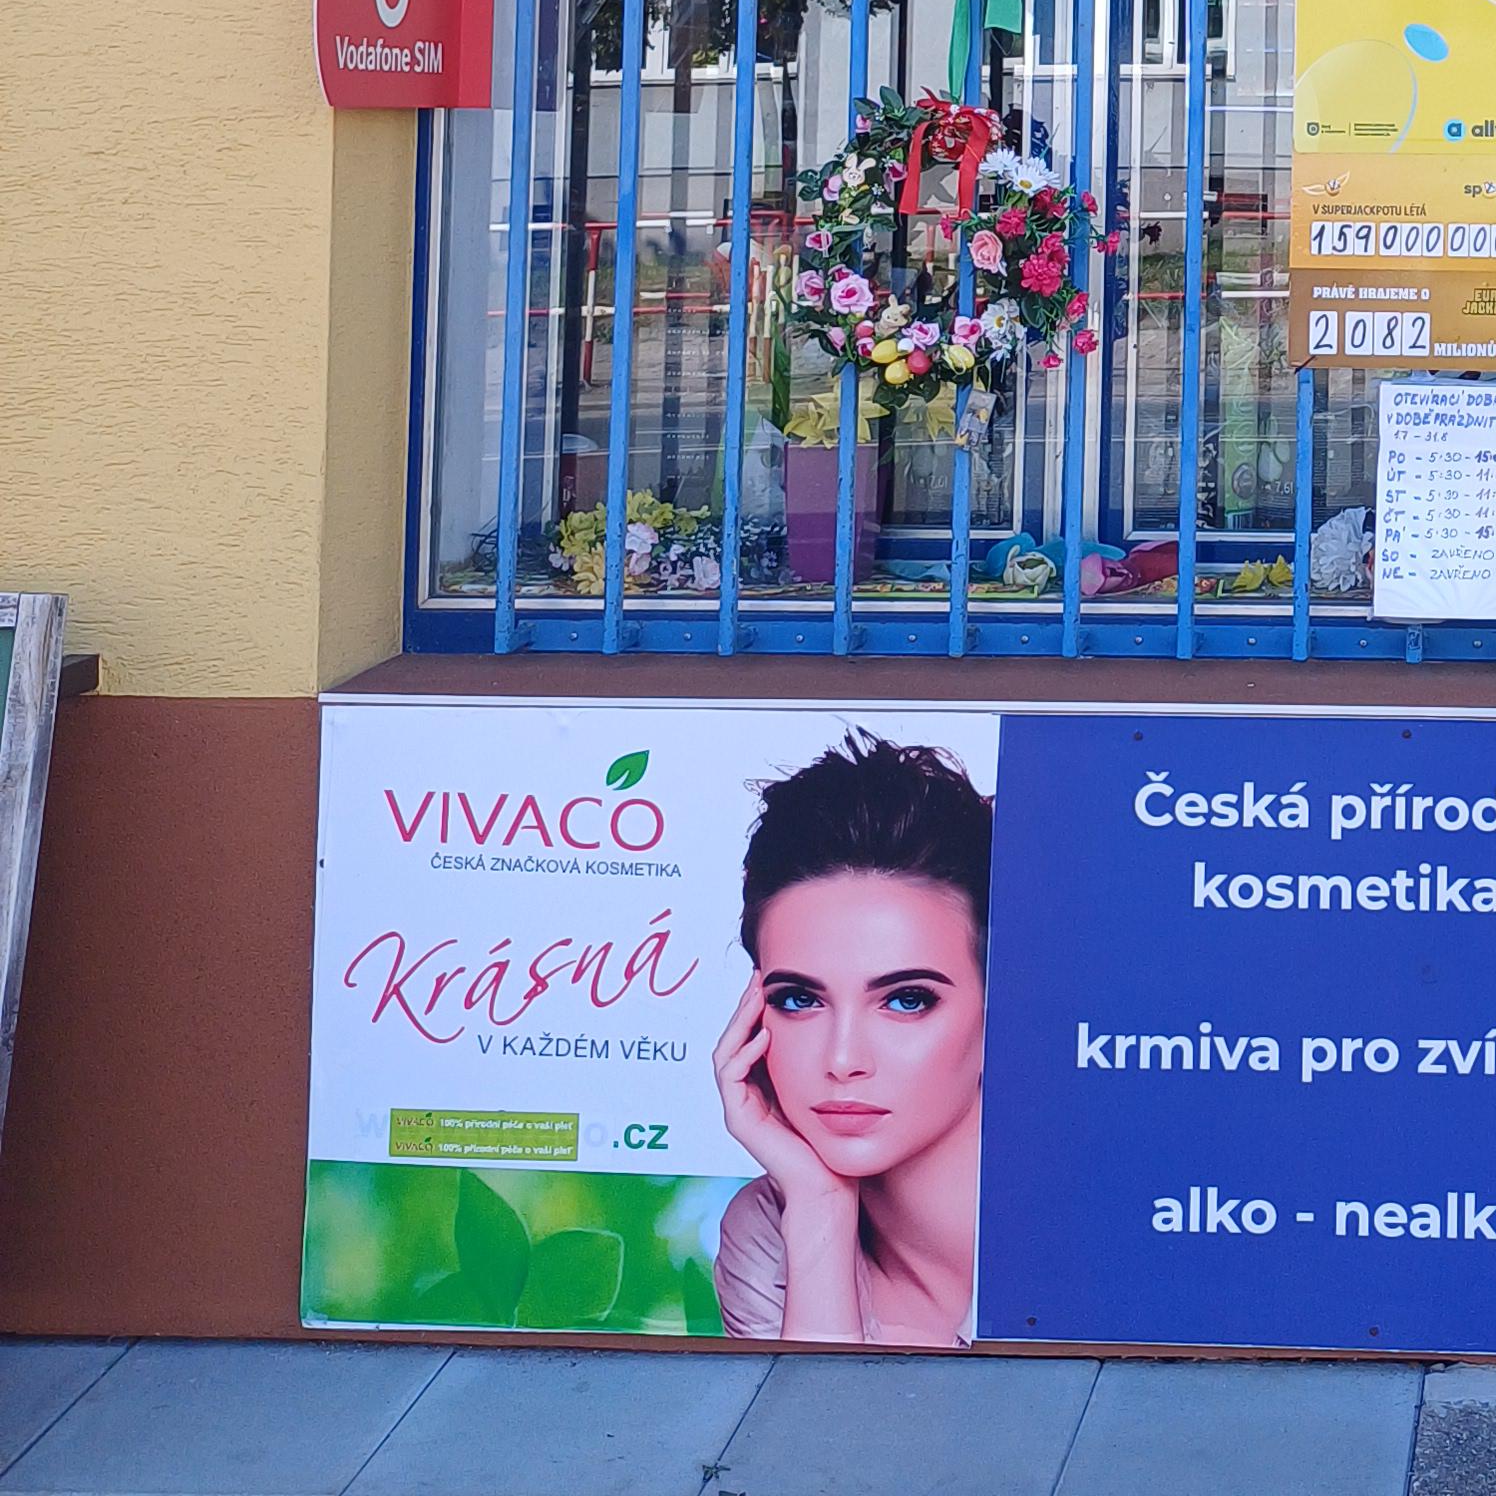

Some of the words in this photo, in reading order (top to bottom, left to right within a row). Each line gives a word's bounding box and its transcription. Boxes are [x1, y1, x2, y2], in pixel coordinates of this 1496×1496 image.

[335, 36, 412, 73] Vodafone
[414, 41, 444, 74] SIM
[1312, 205, 1320, 215] V
[1321, 204, 1402, 216] SUPERJACKPOTU
[1403, 202, 1427, 216] LÉTÁ
[1312, 283, 1356, 300] PRÁVĚ
[1358, 288, 1418, 300] HRAJEME
[1420, 288, 1431, 301] O
[1395, 408, 1433, 427] DOBĚ
[1388, 450, 1406, 464] PO
[1386, 467, 1407, 481] ÚT
[1385, 489, 1407, 504] ST
[1383, 507, 1406, 524] ČT
[1384, 526, 1406, 544] PÁ
[1381, 549, 1400, 563] SO
[1431, 544, 1495, 560] ZAVŘENO
[1381, 566, 1404, 580] NE
[1430, 565, 1491, 581] ZAVŘENO
[1134, 770, 1310, 829] Česká
[384, 789, 666, 852] VIVACO
[430, 851, 487, 873] ČESKÁ
[489, 854, 581, 875] ZNAČKOVÁ
[585, 860, 682, 878] KOSMETIKA
[344, 908, 700, 1044] Krásná
[477, 1034, 494, 1055] V
[502, 1031, 610, 1060] KAŽDÉM
[619, 1034, 688, 1063] VĚKU
[1076, 1021, 1281, 1072] krmiva
[1301, 1034, 1401, 1084] pro
[1151, 1186, 1278, 1235] alko
[1295, 1212, 1315, 1222] -
